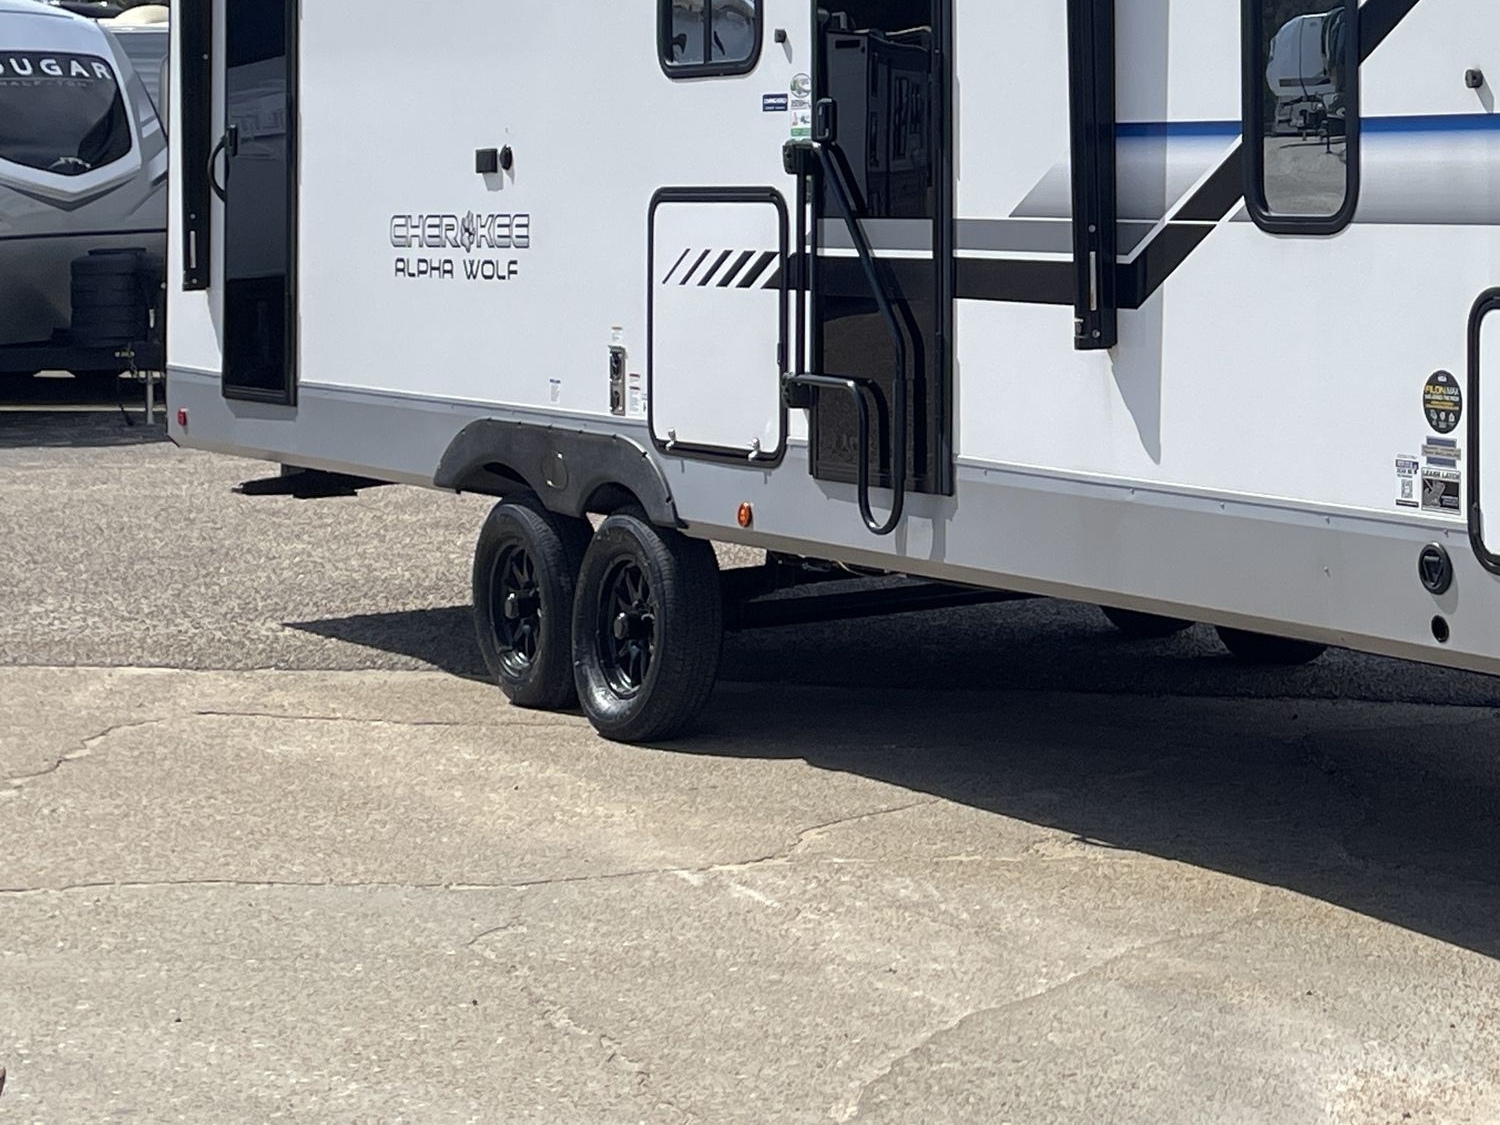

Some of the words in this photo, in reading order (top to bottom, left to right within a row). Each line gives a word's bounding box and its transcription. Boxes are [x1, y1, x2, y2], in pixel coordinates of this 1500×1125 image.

[0, 57, 112, 80] UGAR
[394, 257, 454, 279] ALPHA
[463, 258, 518, 280] WOLF
